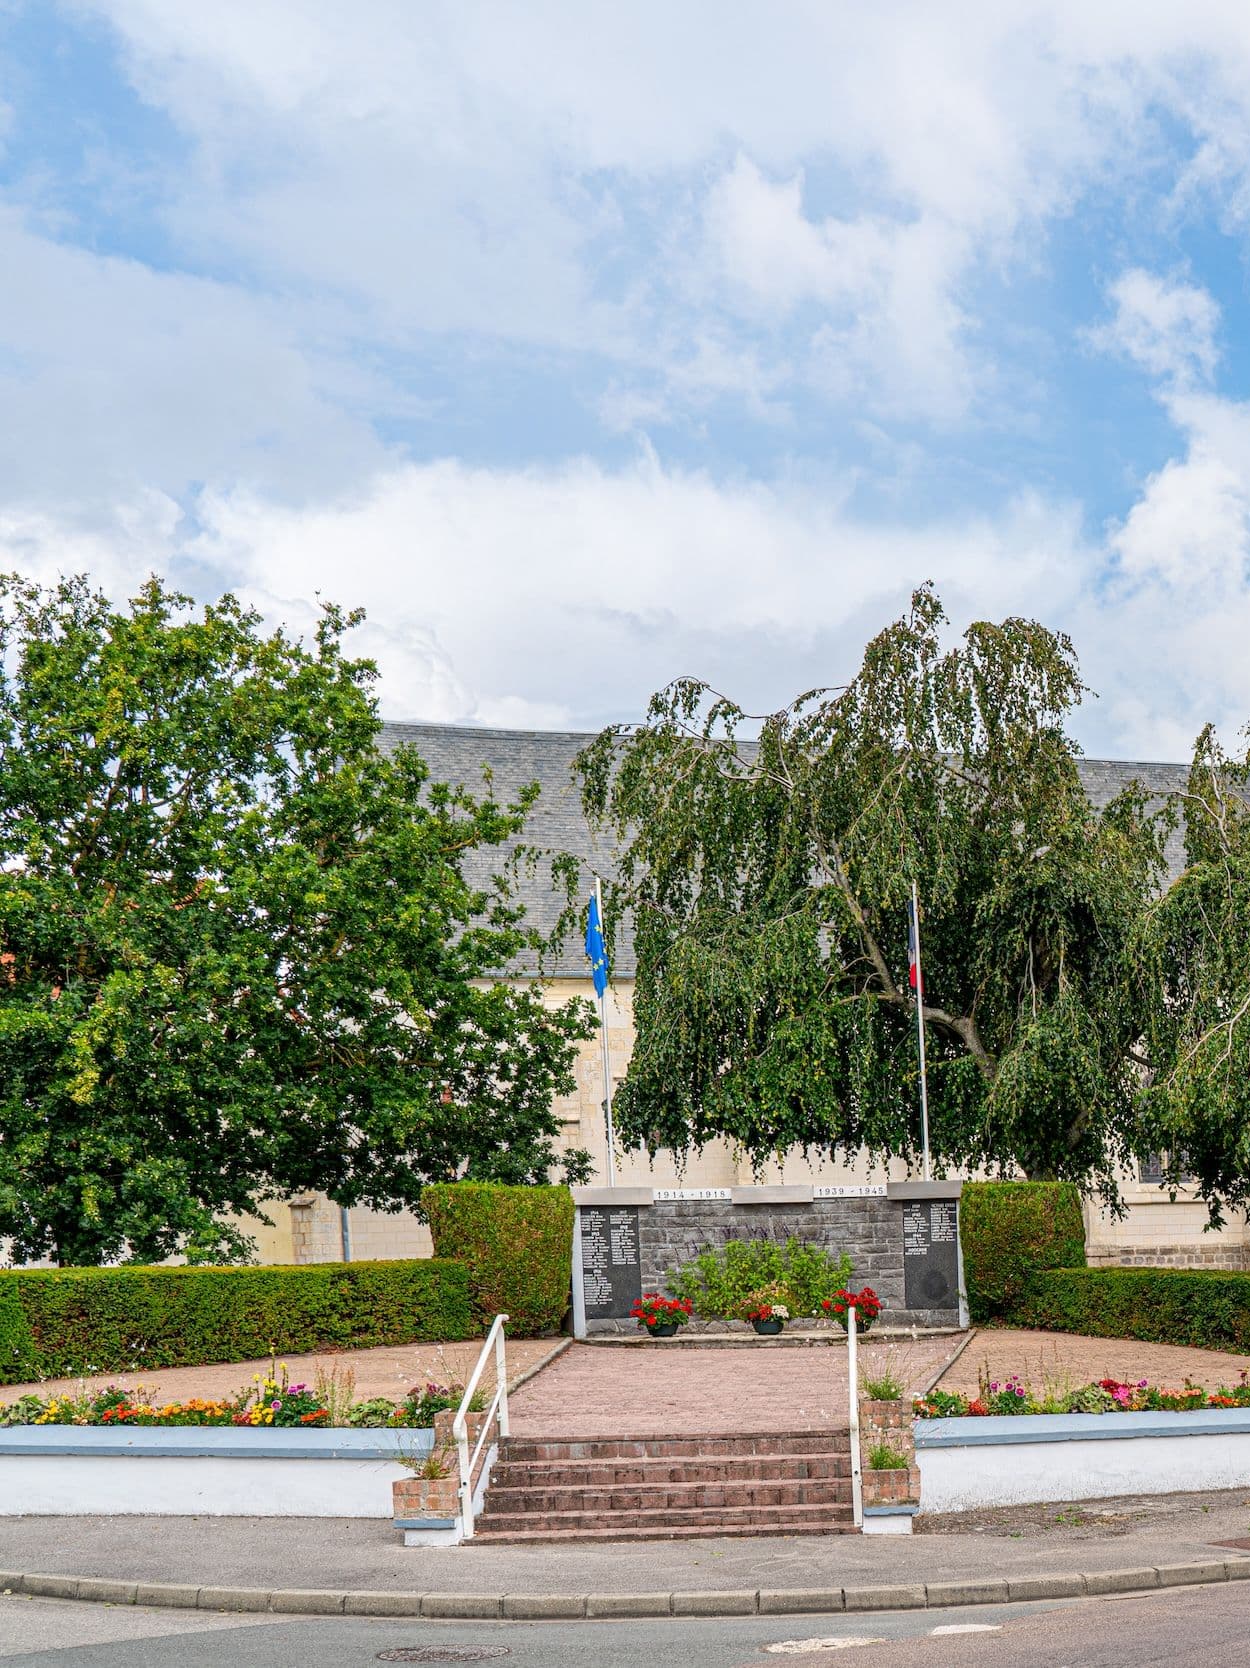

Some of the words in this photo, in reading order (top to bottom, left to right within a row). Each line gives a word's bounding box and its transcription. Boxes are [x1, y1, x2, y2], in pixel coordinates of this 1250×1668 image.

[657, 1191, 685, 1199] 1914
[699, 1190, 725, 1198] 1918
[819, 1187, 844, 1196] 1939
[859, 1186, 884, 1195] 1945
